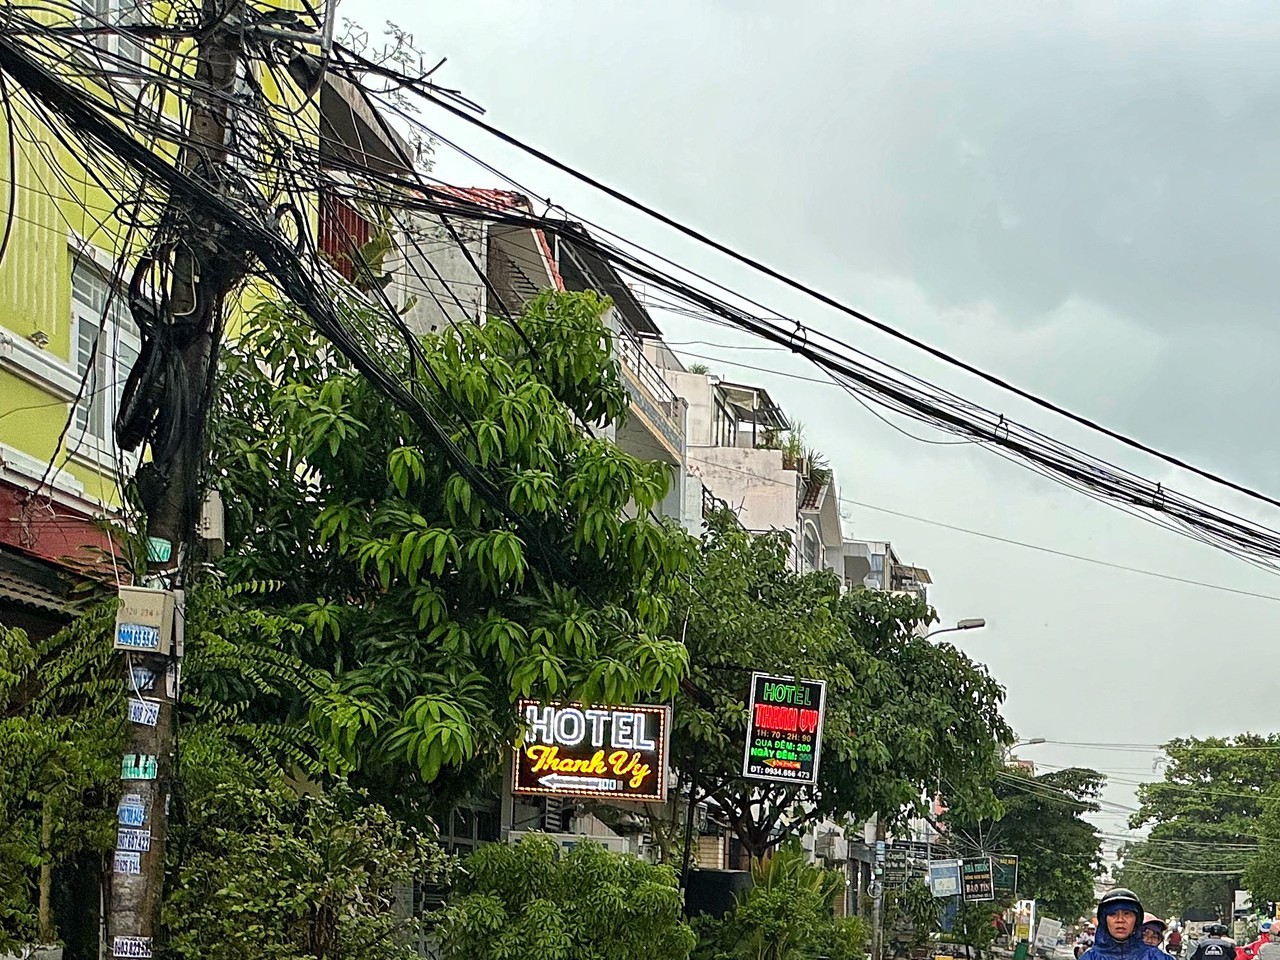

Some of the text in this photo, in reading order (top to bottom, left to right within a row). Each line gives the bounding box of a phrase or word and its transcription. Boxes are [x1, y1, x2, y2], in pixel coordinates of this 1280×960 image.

[763, 682, 812, 706] HOTEL
[525, 705, 655, 751] HOTEL
[771, 730, 781, 739] 70
[750, 747, 775, 758] NGÀY
[755, 738, 773, 748] QUA
[797, 743, 812, 752] 200
[526, 744, 651, 789] Thanh Vy
